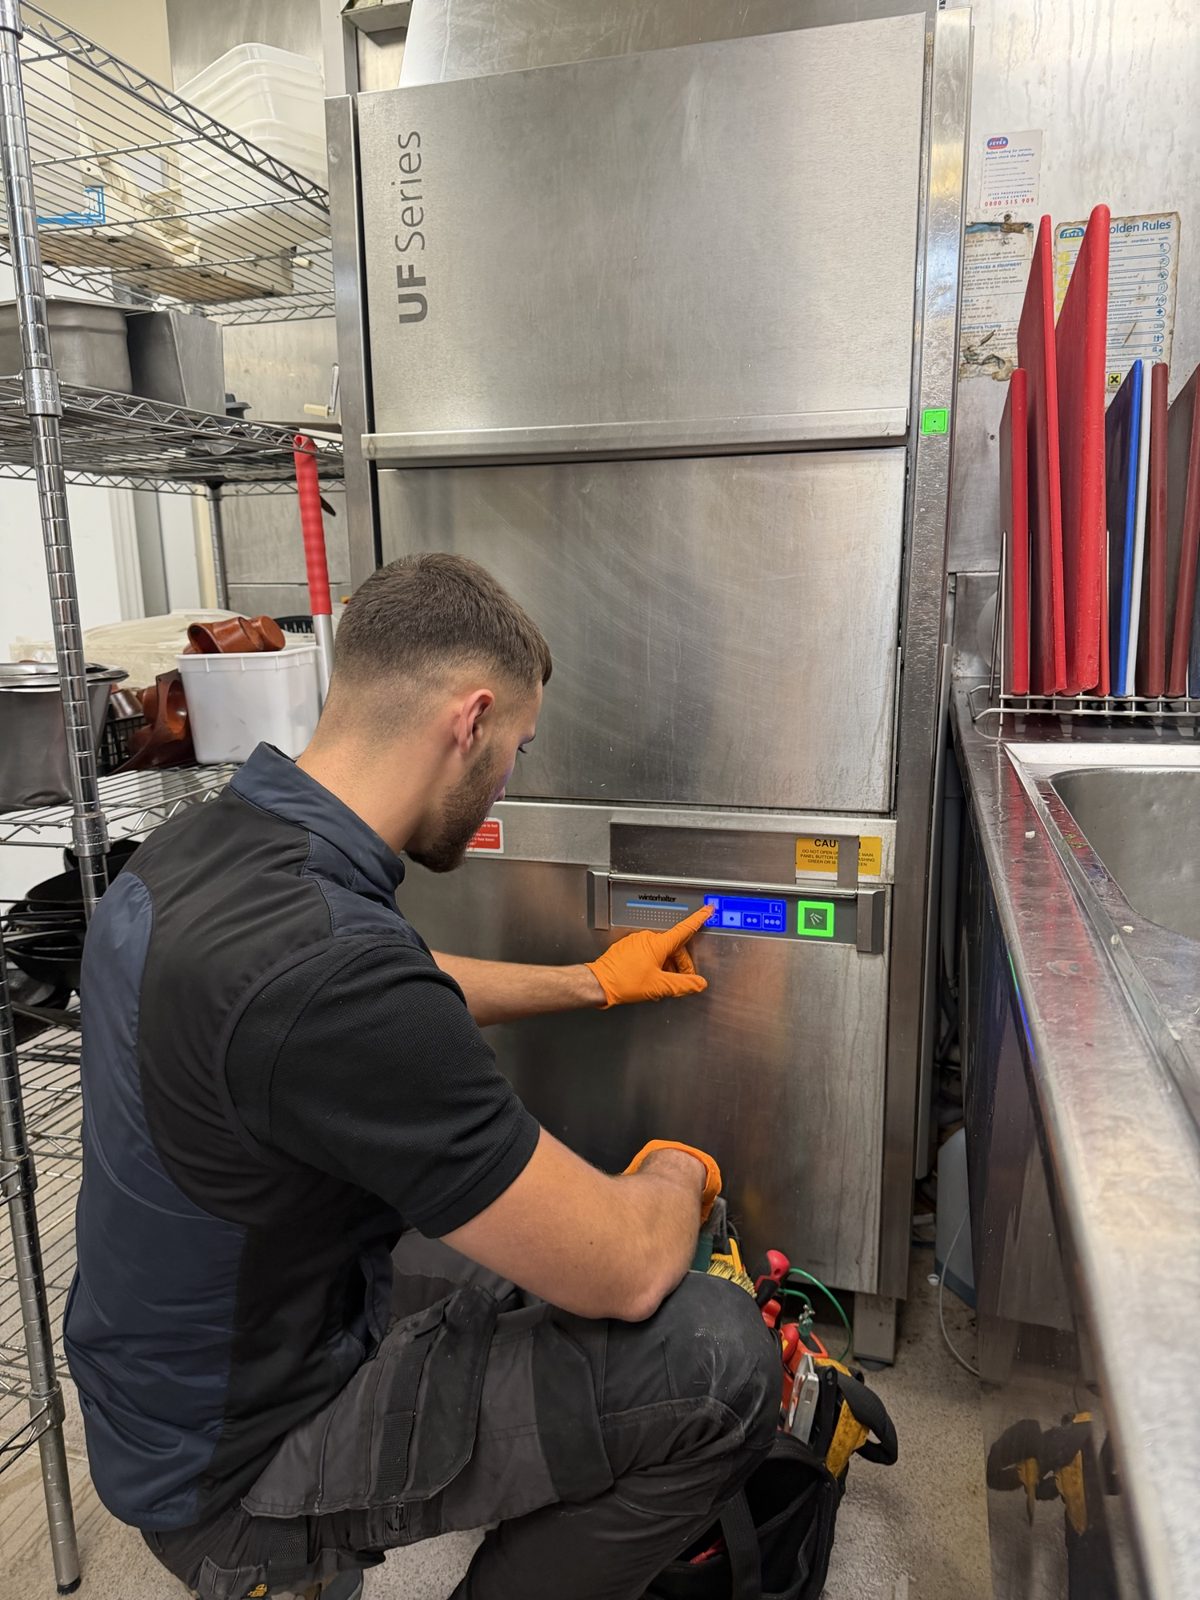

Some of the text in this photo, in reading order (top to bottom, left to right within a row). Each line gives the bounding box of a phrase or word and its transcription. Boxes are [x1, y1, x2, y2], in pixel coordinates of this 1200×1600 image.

[391, 131, 428, 324] UF Series
[1109, 219, 1171, 234] olden Rules
